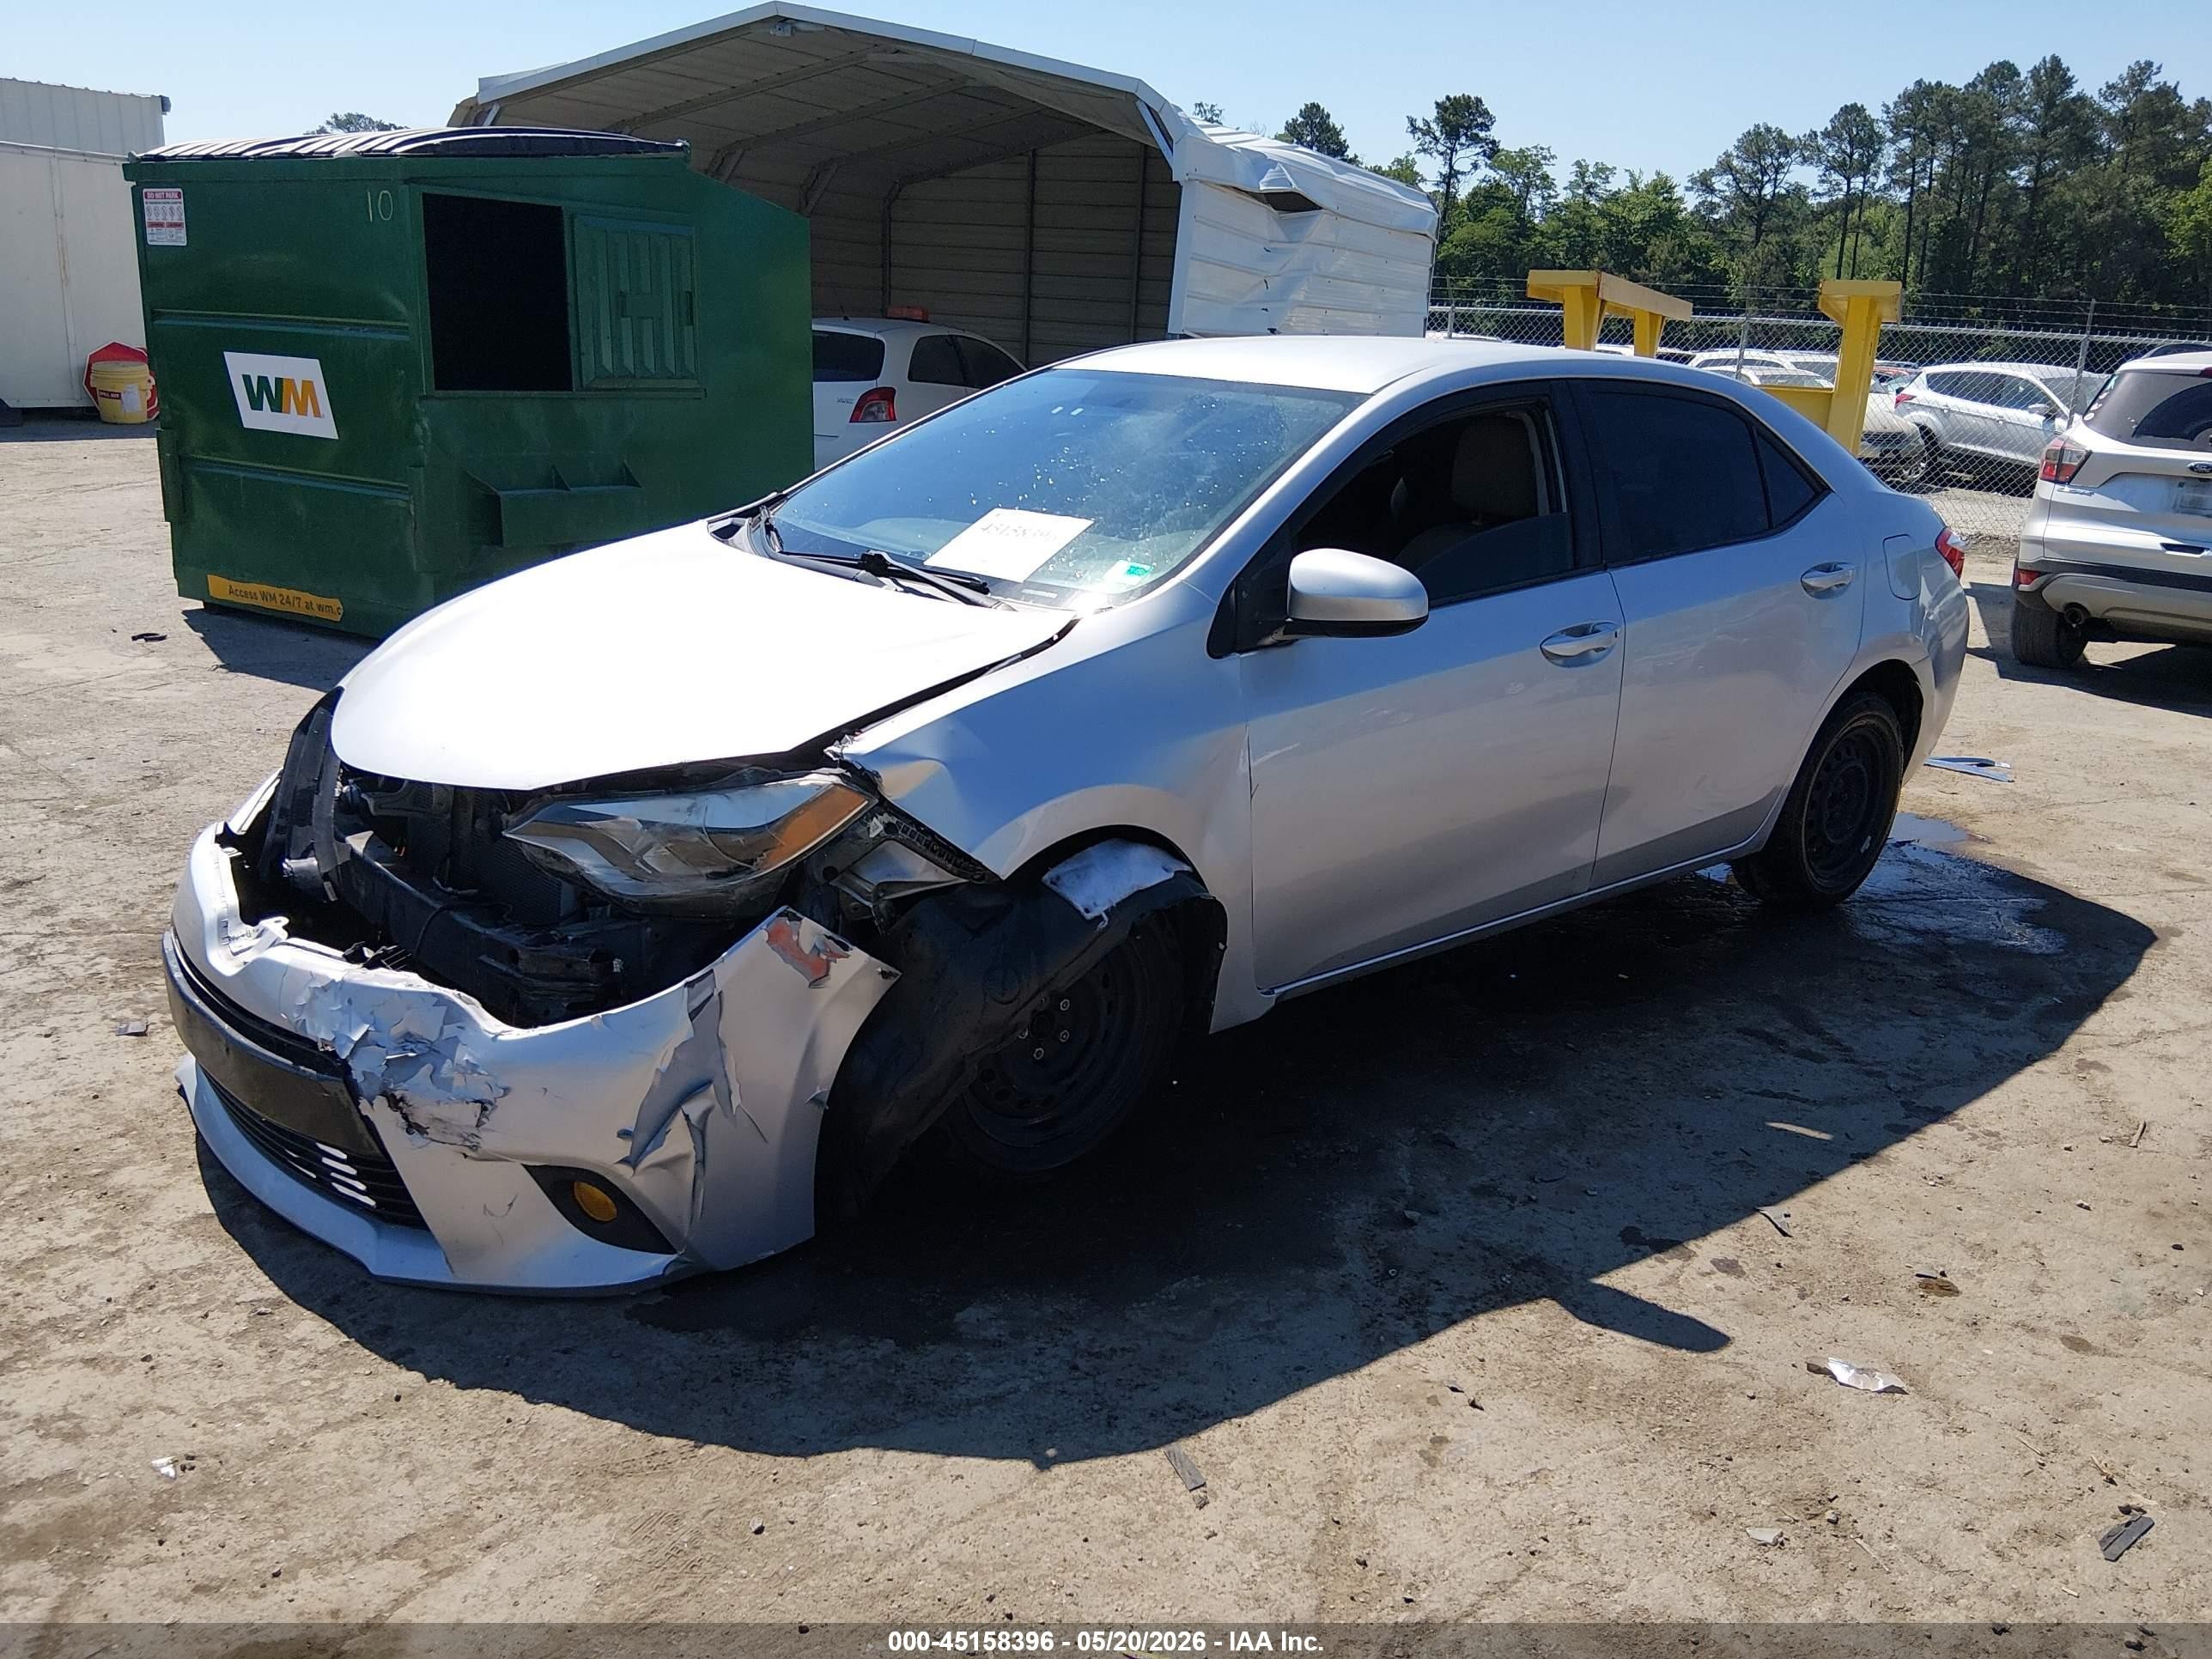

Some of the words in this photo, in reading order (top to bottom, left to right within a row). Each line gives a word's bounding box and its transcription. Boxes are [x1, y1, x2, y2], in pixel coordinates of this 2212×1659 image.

[367, 189, 393, 222] 10
[241, 374, 322, 418] WM
[228, 585, 258, 600] Access
[260, 590, 276, 602] WM
[279, 593, 301, 608] 24/7
[305, 600, 313, 611] at
